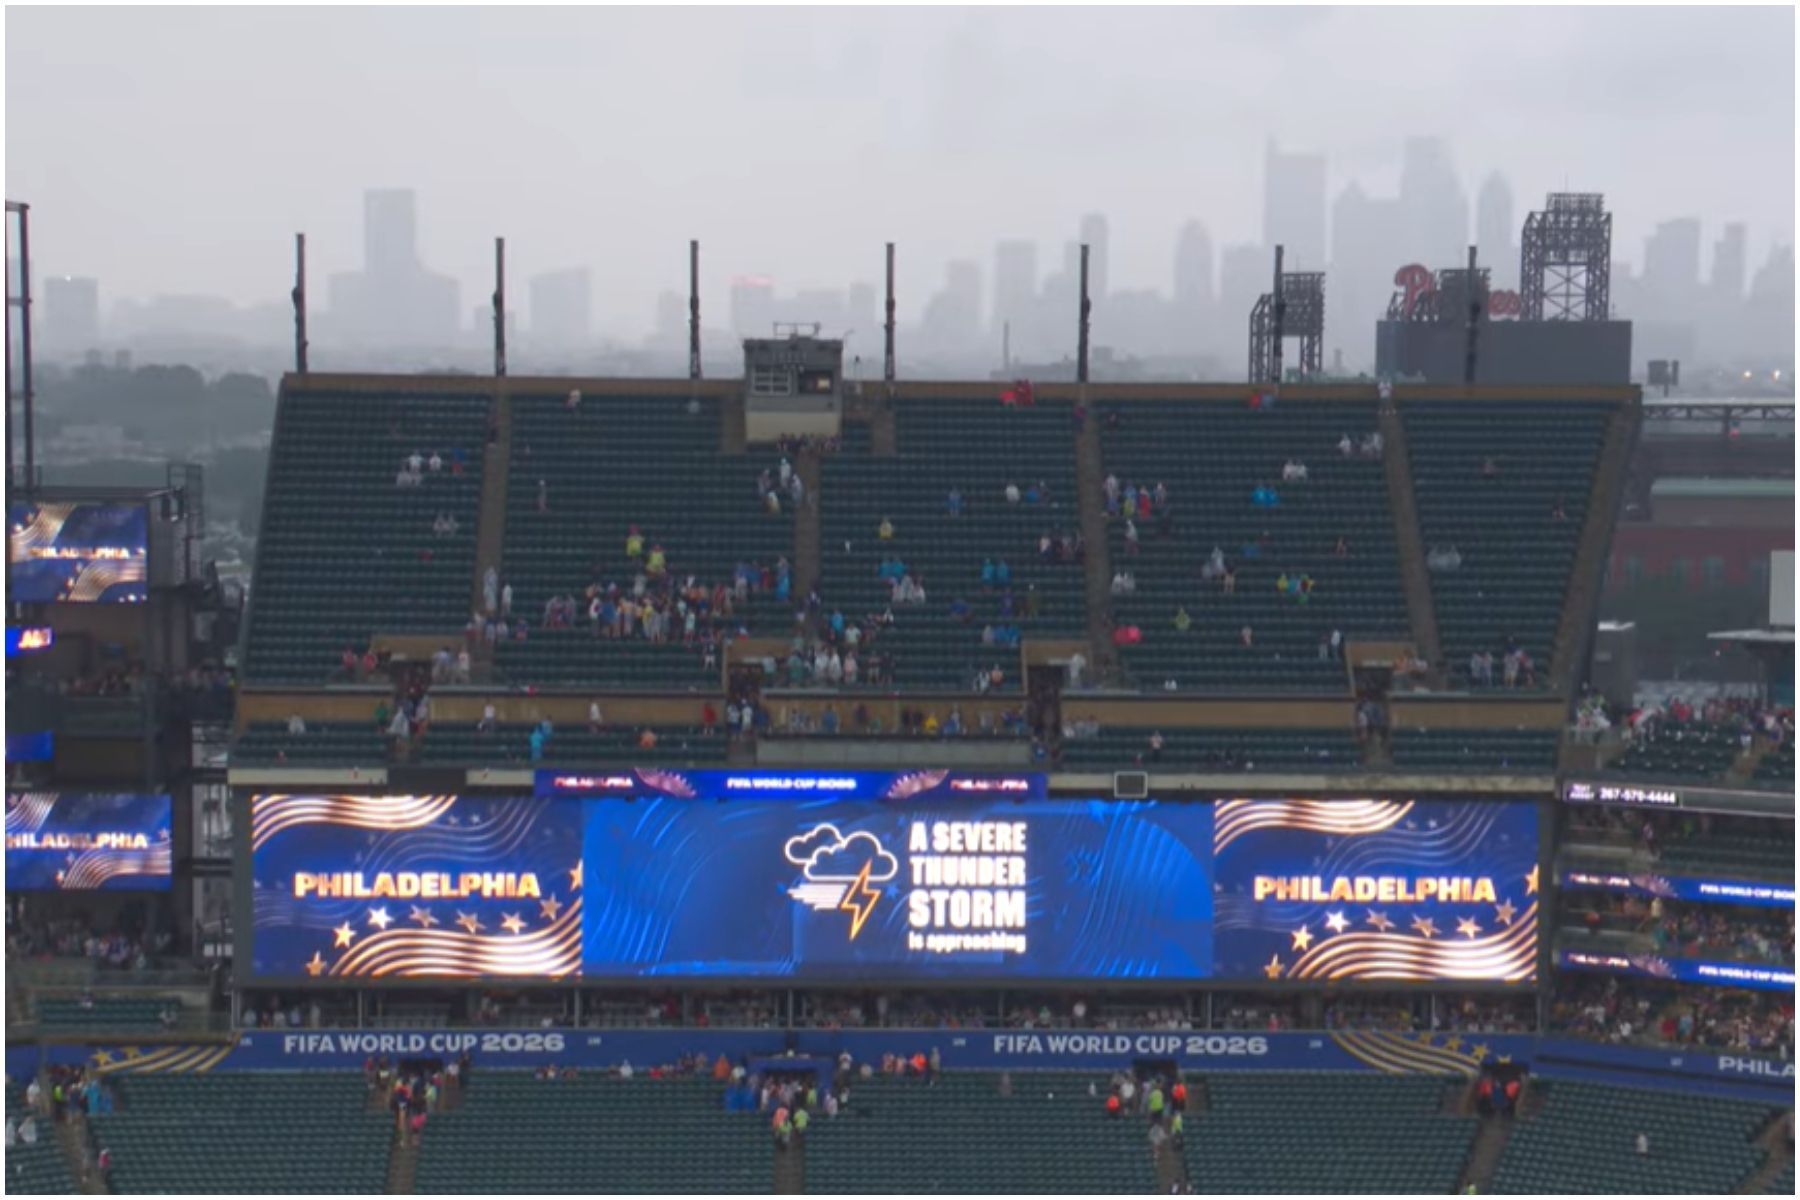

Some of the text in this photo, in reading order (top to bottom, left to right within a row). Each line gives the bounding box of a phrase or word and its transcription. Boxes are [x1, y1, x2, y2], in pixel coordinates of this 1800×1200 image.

[909, 821, 1027, 852] A SEVERE
[909, 856, 1026, 886] THUNDER
[294, 872, 541, 899] PHILADELPHIA
[1254, 874, 1496, 902] PHILADELPHIA
[909, 889, 1026, 928] STORM
[926, 931, 1026, 953] approaching
[284, 1034, 336, 1053] FIFA
[339, 1034, 425, 1053] WORLD
[430, 1033, 478, 1052] CUP
[481, 1033, 566, 1052] 2026
[993, 1034, 1268, 1055] FIFA WORLD CUP 2026
[1718, 1056, 1795, 1077] PHILA
